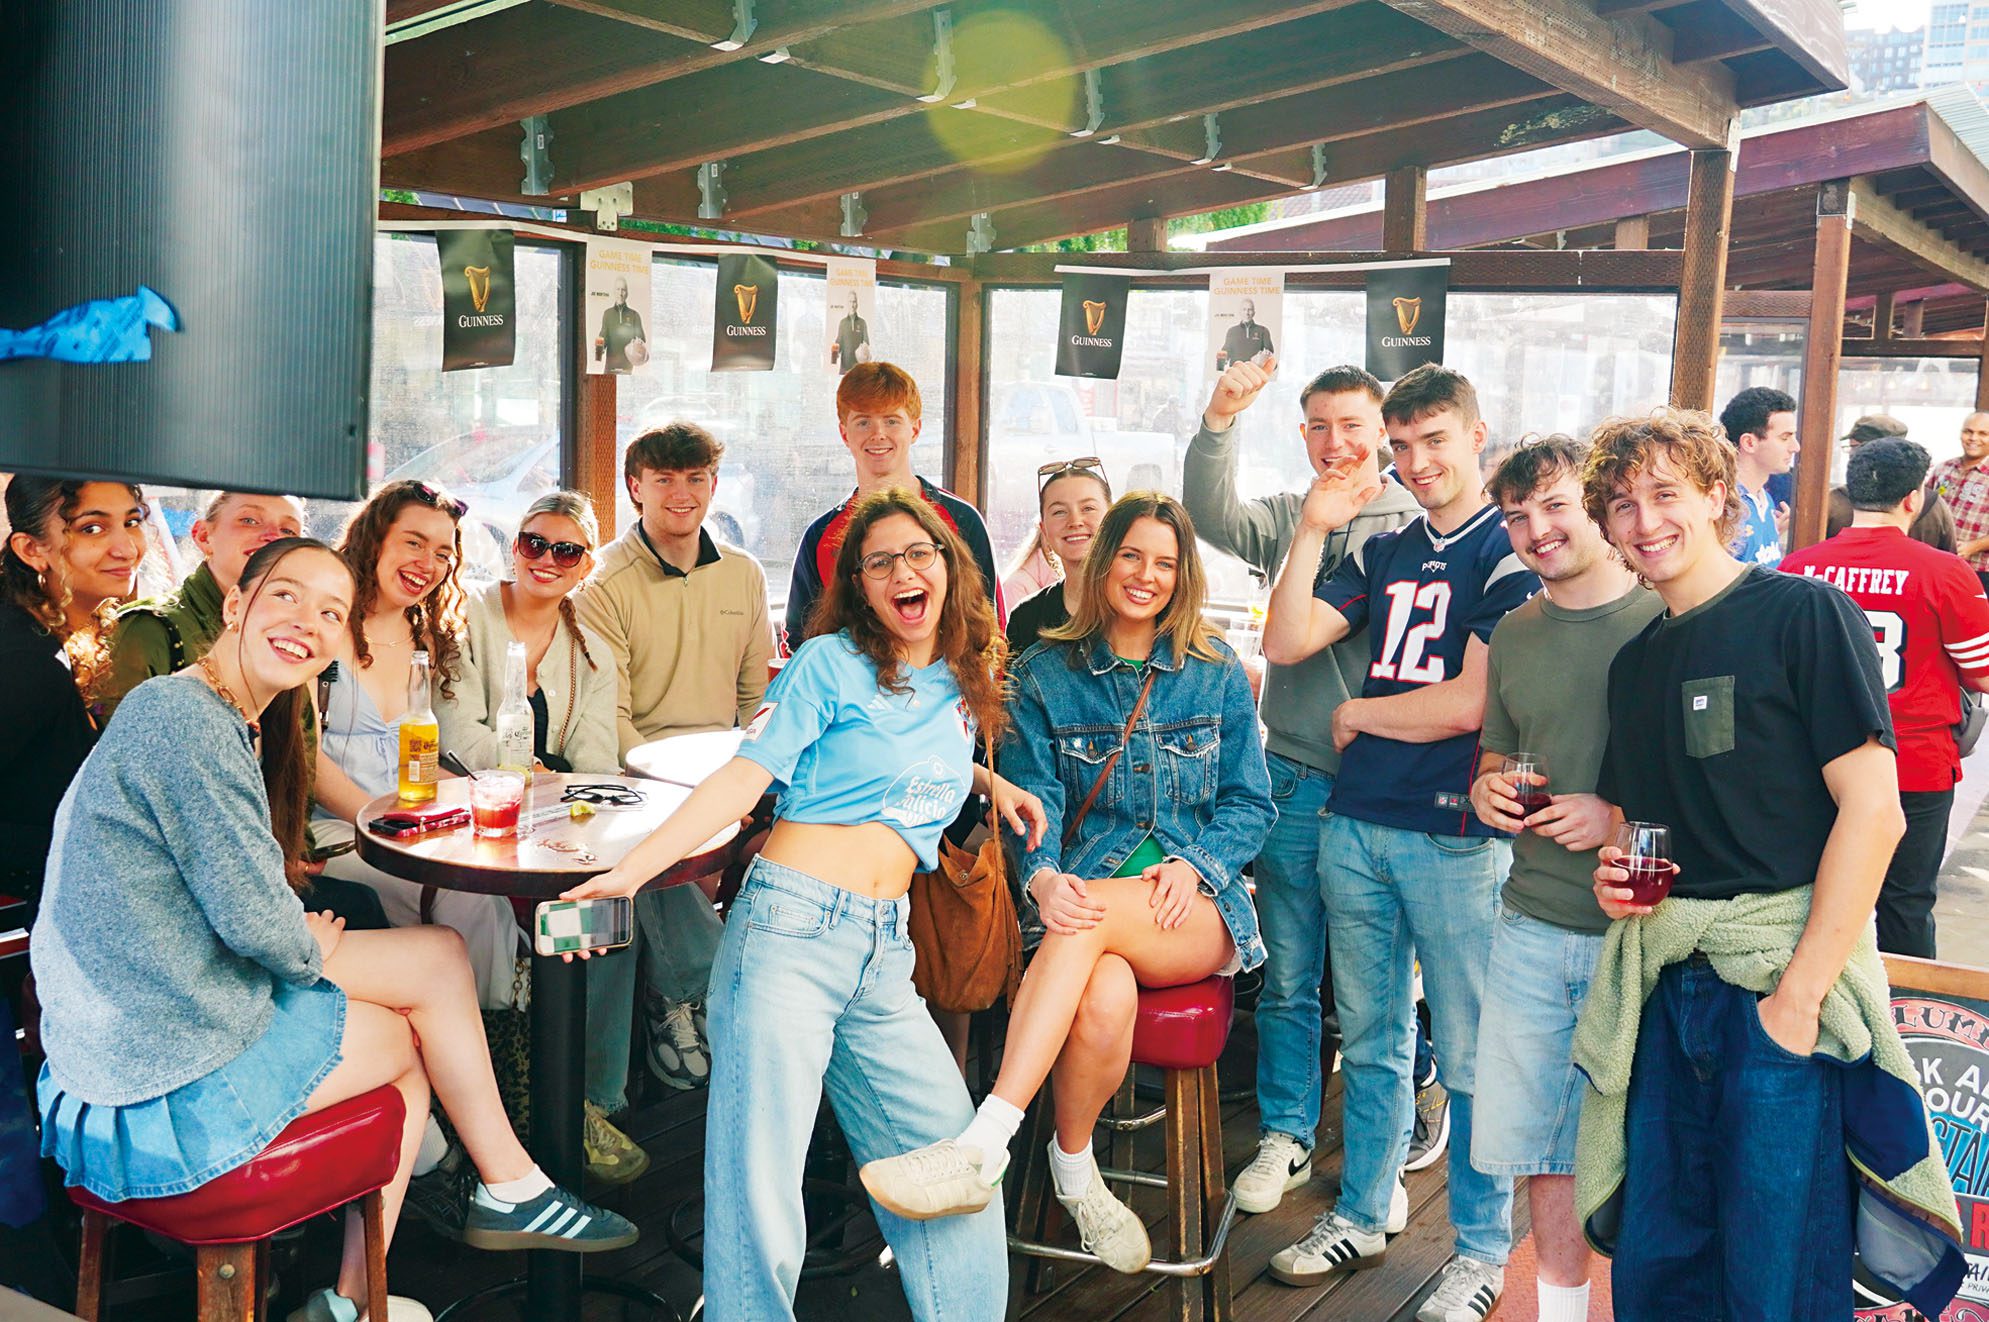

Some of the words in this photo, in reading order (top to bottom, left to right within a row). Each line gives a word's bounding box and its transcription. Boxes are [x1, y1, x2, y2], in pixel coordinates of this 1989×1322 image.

[590, 260, 628, 272] GUINNESS
[629, 264, 649, 275] TIME
[1223, 277, 1249, 286] GAME
[1252, 277, 1272, 285] TIME
[1213, 287, 1257, 295] GUINNESS
[1259, 286, 1281, 295] TIME
[458, 314, 504, 328] GUINNESS
[726, 324, 767, 337] GUINNESS
[1071, 334, 1113, 348] GUINNESS
[1381, 335, 1432, 348] GUINNESS
[1804, 565, 1910, 596] CAFFREY
[1370, 580, 1452, 685] 12
[904, 775, 956, 805] Estrella
